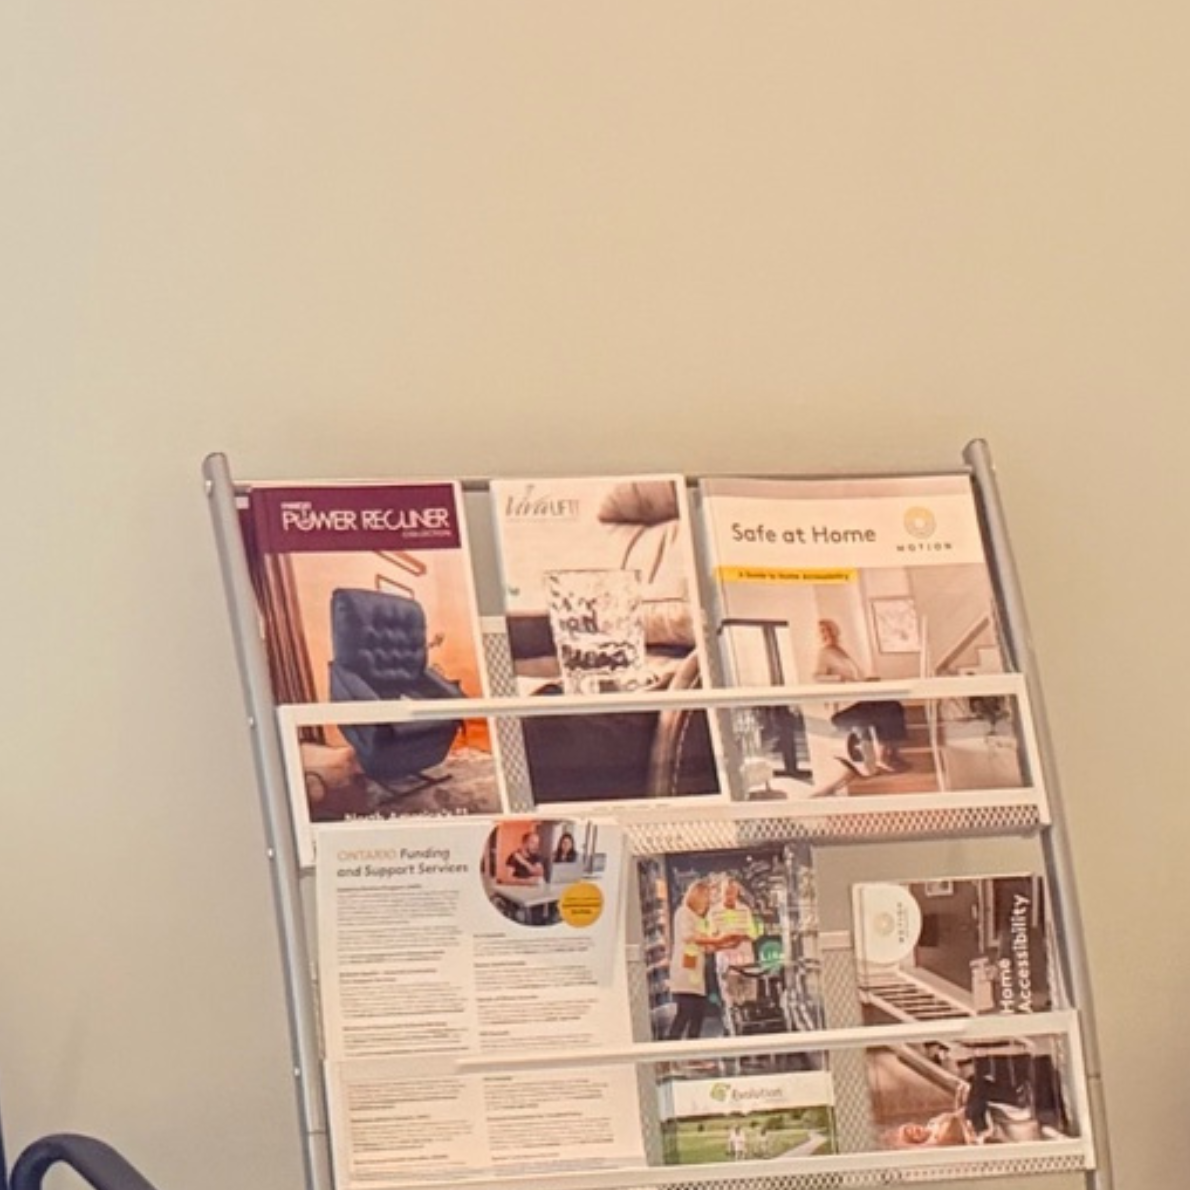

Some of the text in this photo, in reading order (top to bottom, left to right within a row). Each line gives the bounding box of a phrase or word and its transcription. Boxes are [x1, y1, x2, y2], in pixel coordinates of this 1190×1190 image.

[282, 507, 450, 532] POWER RECLINER
[731, 522, 877, 544] Safe at Home
[896, 542, 953, 552] MOTION
[400, 847, 450, 861] Funding
[336, 861, 470, 880] and Support Services
[1010, 894, 1035, 1015] Accessibility
[998, 957, 1016, 1014] Home
